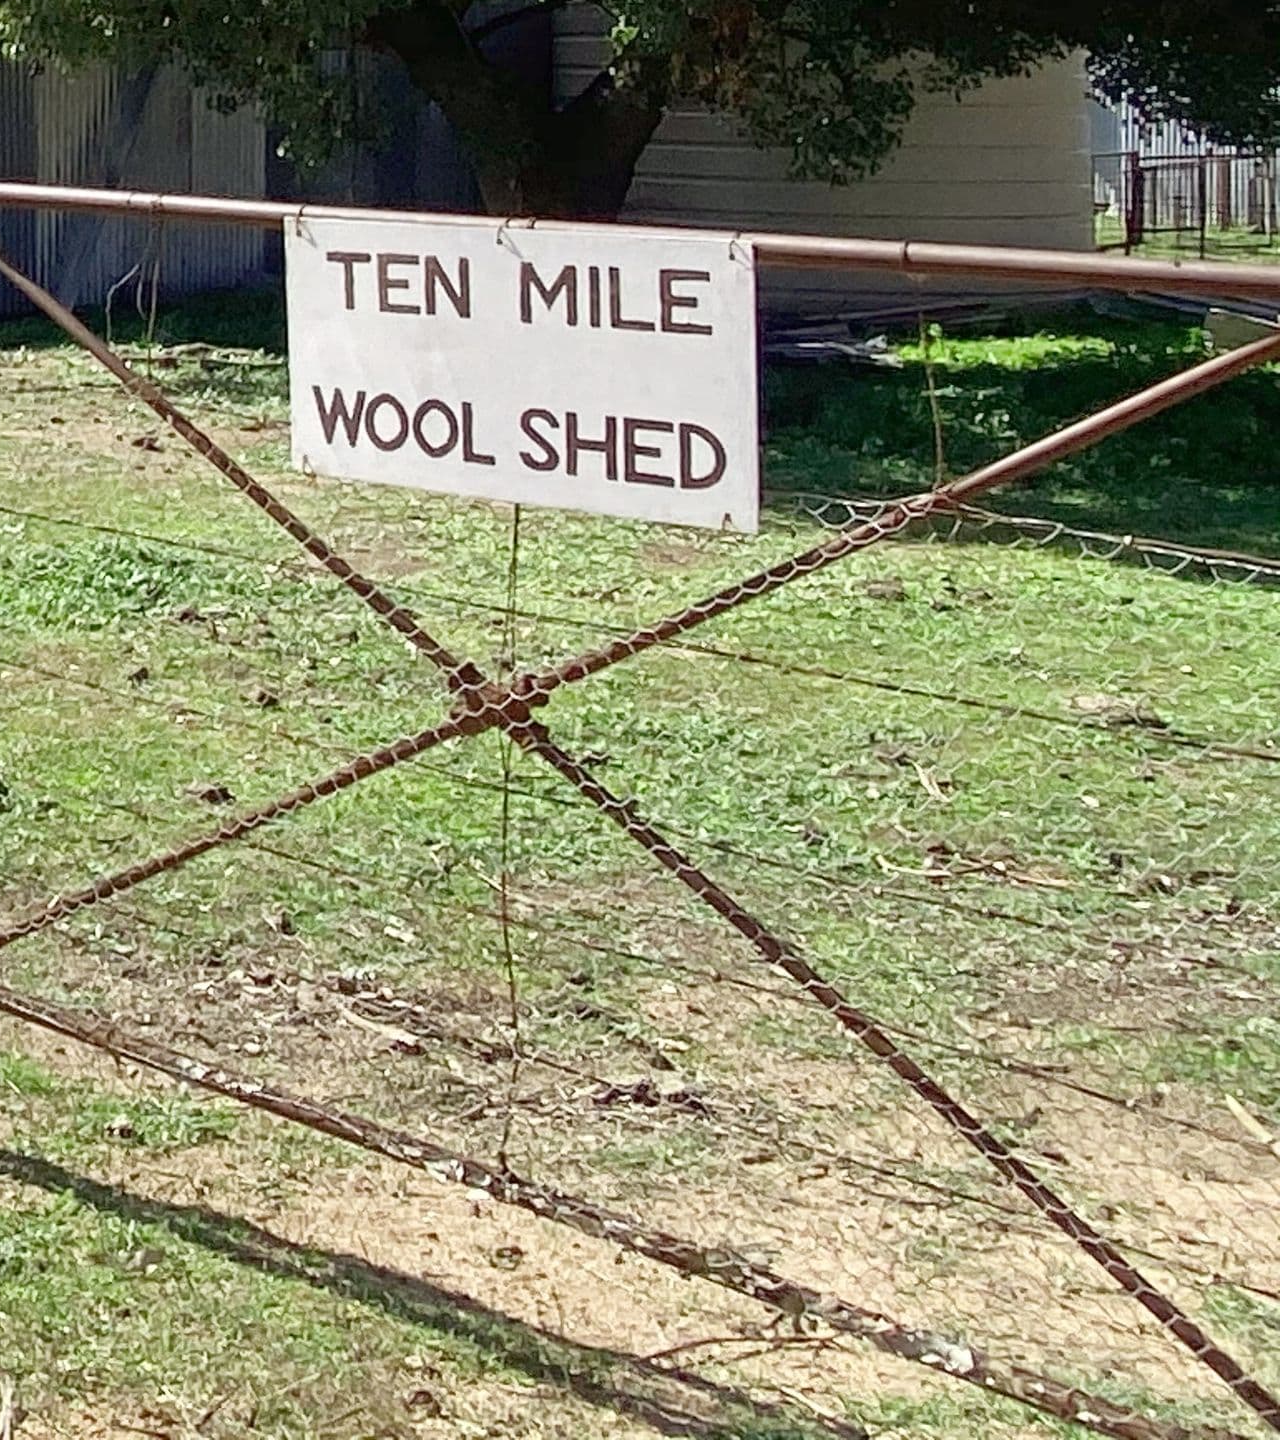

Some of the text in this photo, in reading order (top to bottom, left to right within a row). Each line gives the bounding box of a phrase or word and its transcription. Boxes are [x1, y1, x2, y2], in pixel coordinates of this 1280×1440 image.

[326, 251, 713, 335] TEN MILE
[312, 385, 727, 490] WOOL SHED
